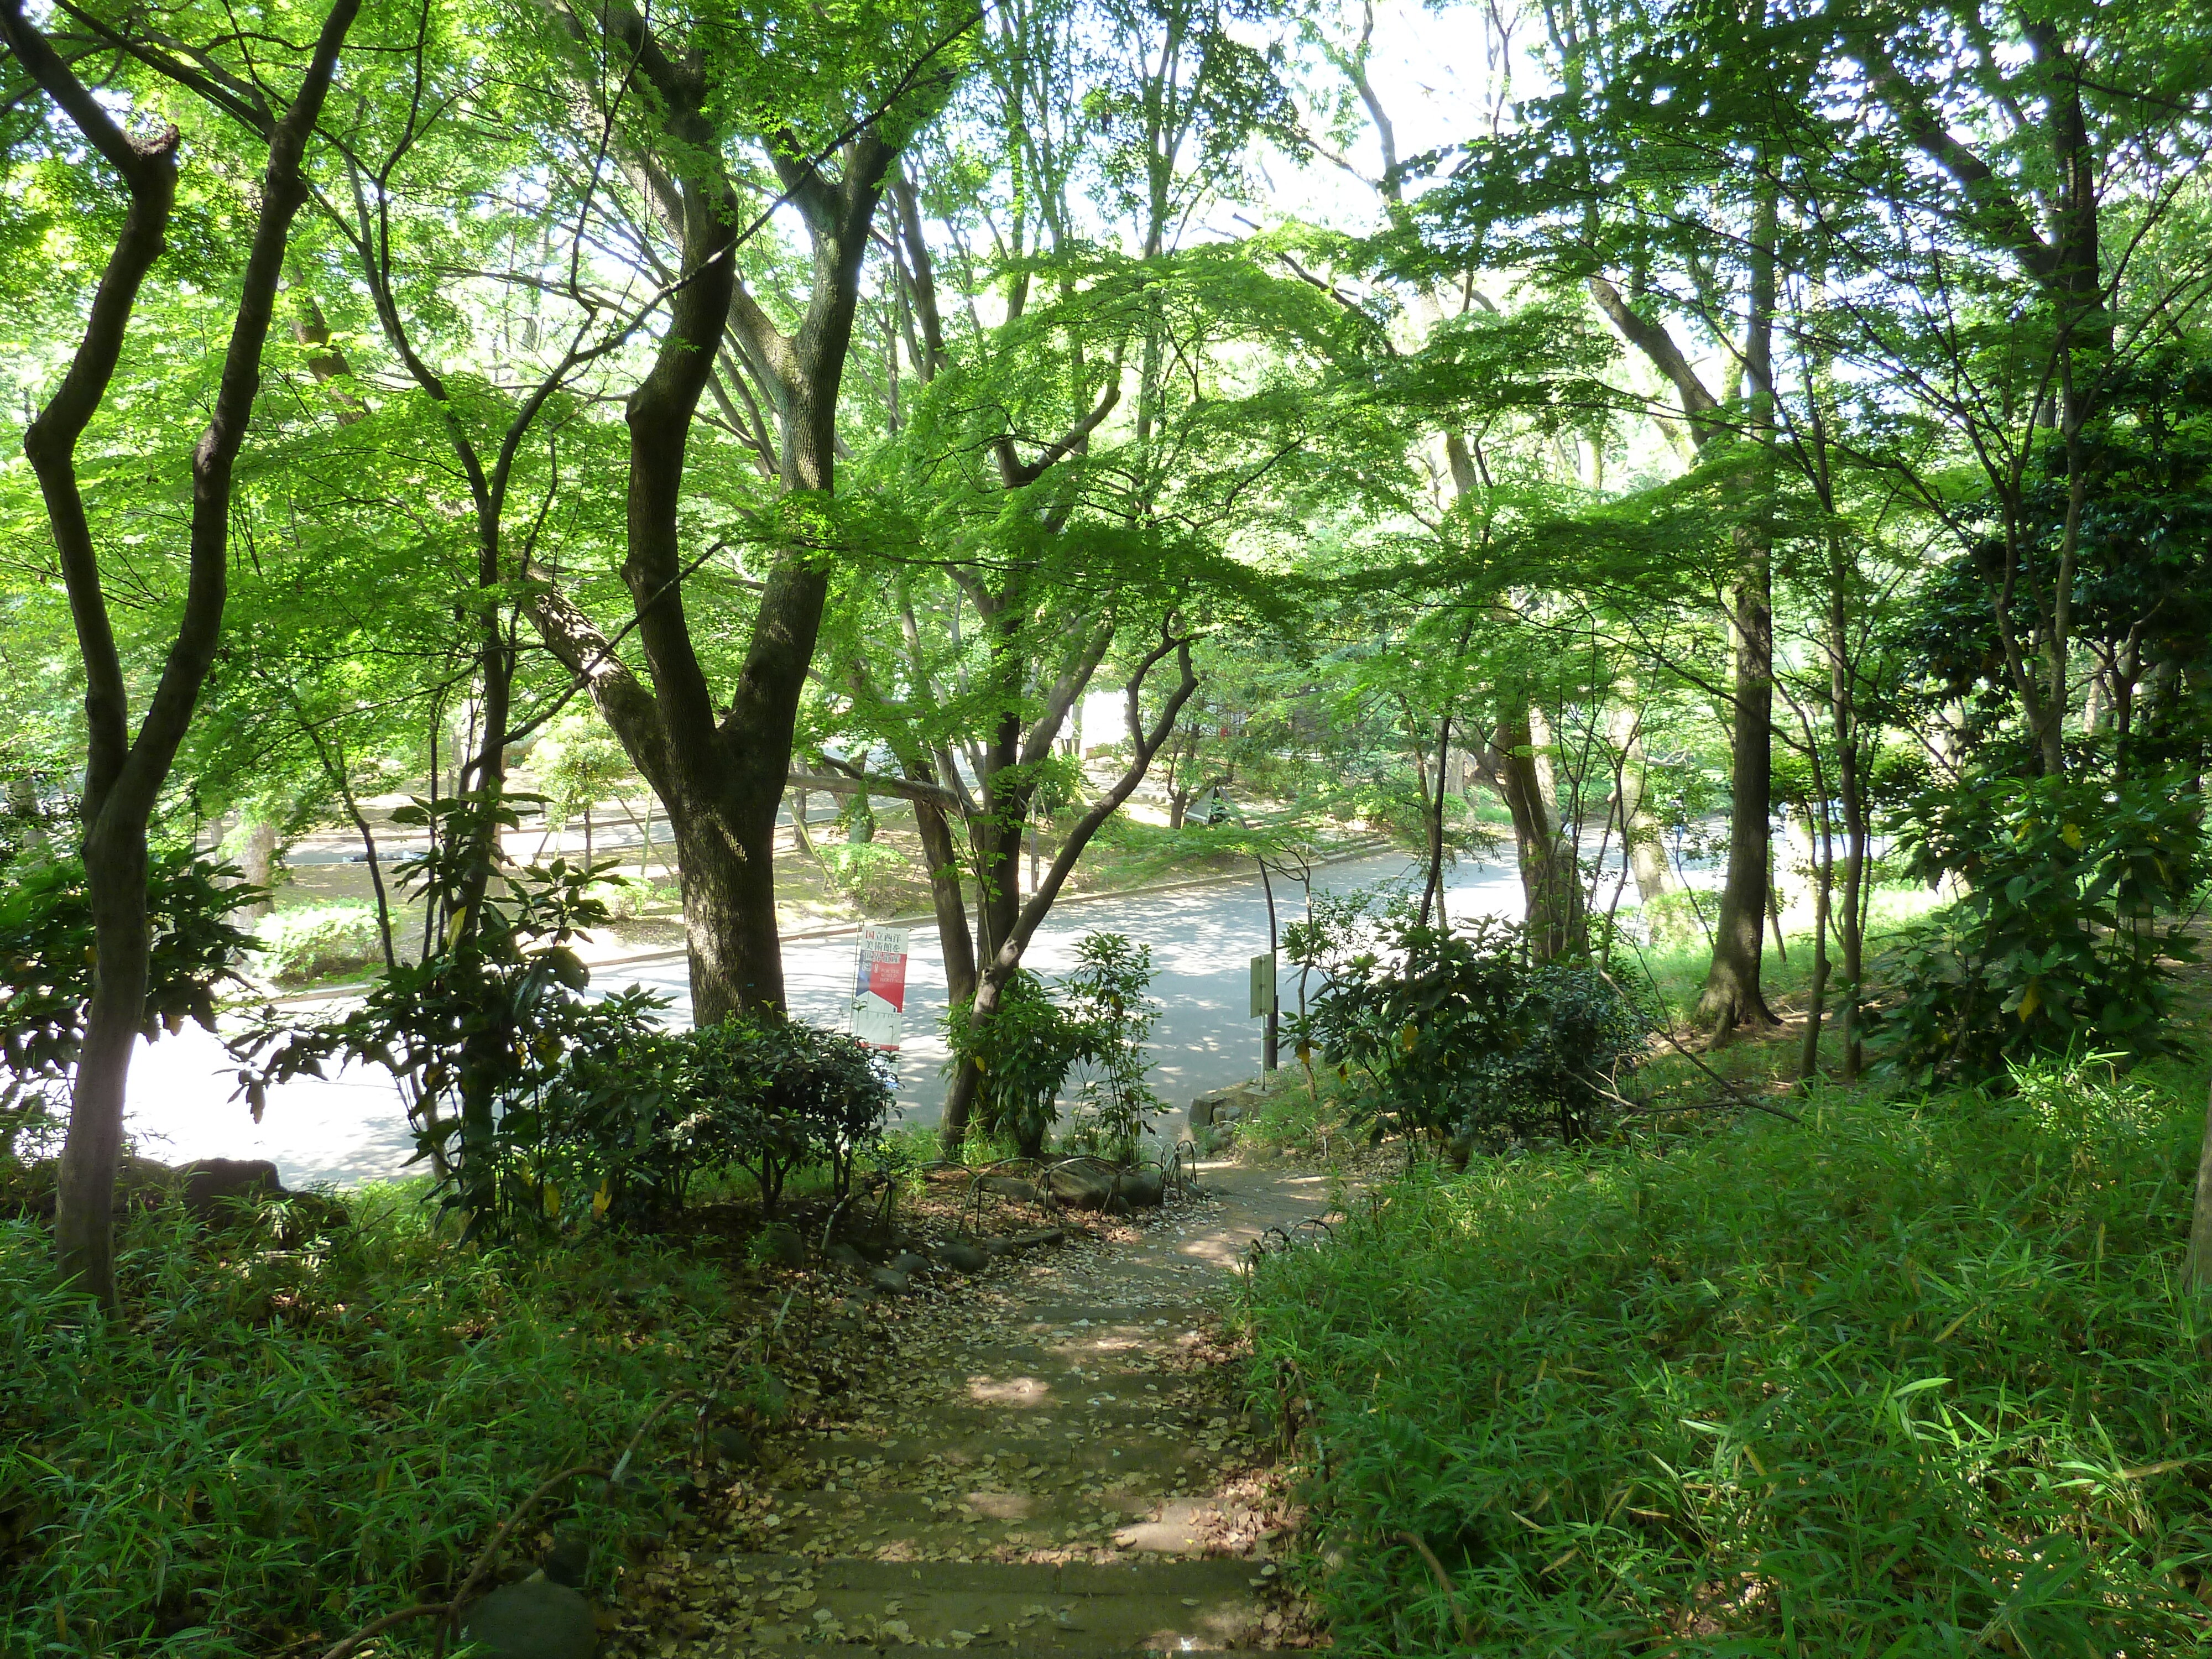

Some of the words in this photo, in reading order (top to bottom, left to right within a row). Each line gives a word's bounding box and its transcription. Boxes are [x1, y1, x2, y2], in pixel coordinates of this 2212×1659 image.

[865, 930, 901, 943] 国立西洋
[865, 940, 900, 953] 美術館を
